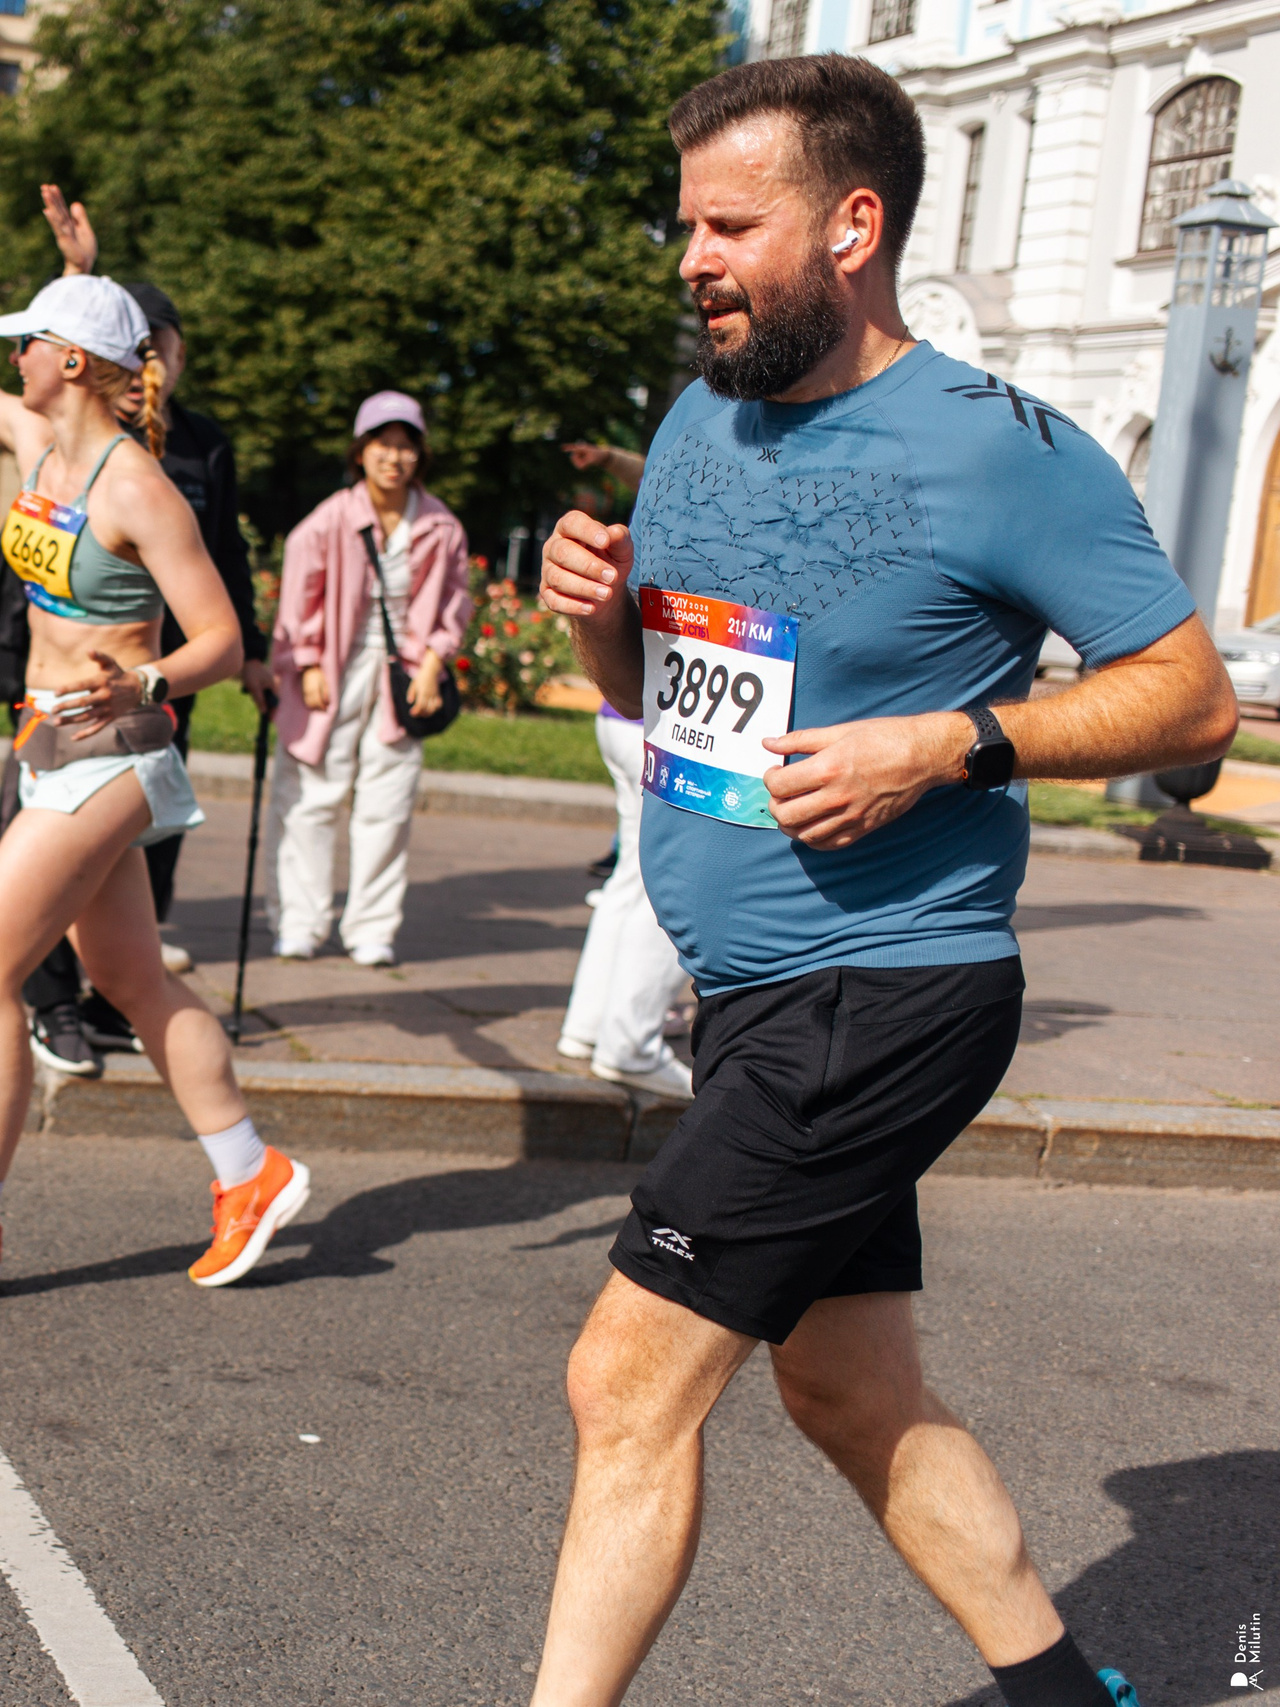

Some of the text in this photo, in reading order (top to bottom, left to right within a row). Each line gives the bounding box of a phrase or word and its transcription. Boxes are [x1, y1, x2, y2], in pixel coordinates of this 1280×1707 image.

[11, 524, 60, 575] 2662
[662, 595, 688, 609] ПОЛУ
[662, 607, 709, 626] МАРАФОН
[727, 617, 748, 636] 21,1
[656, 651, 764, 734] 3899
[671, 724, 715, 752] ПАВЕЛ
